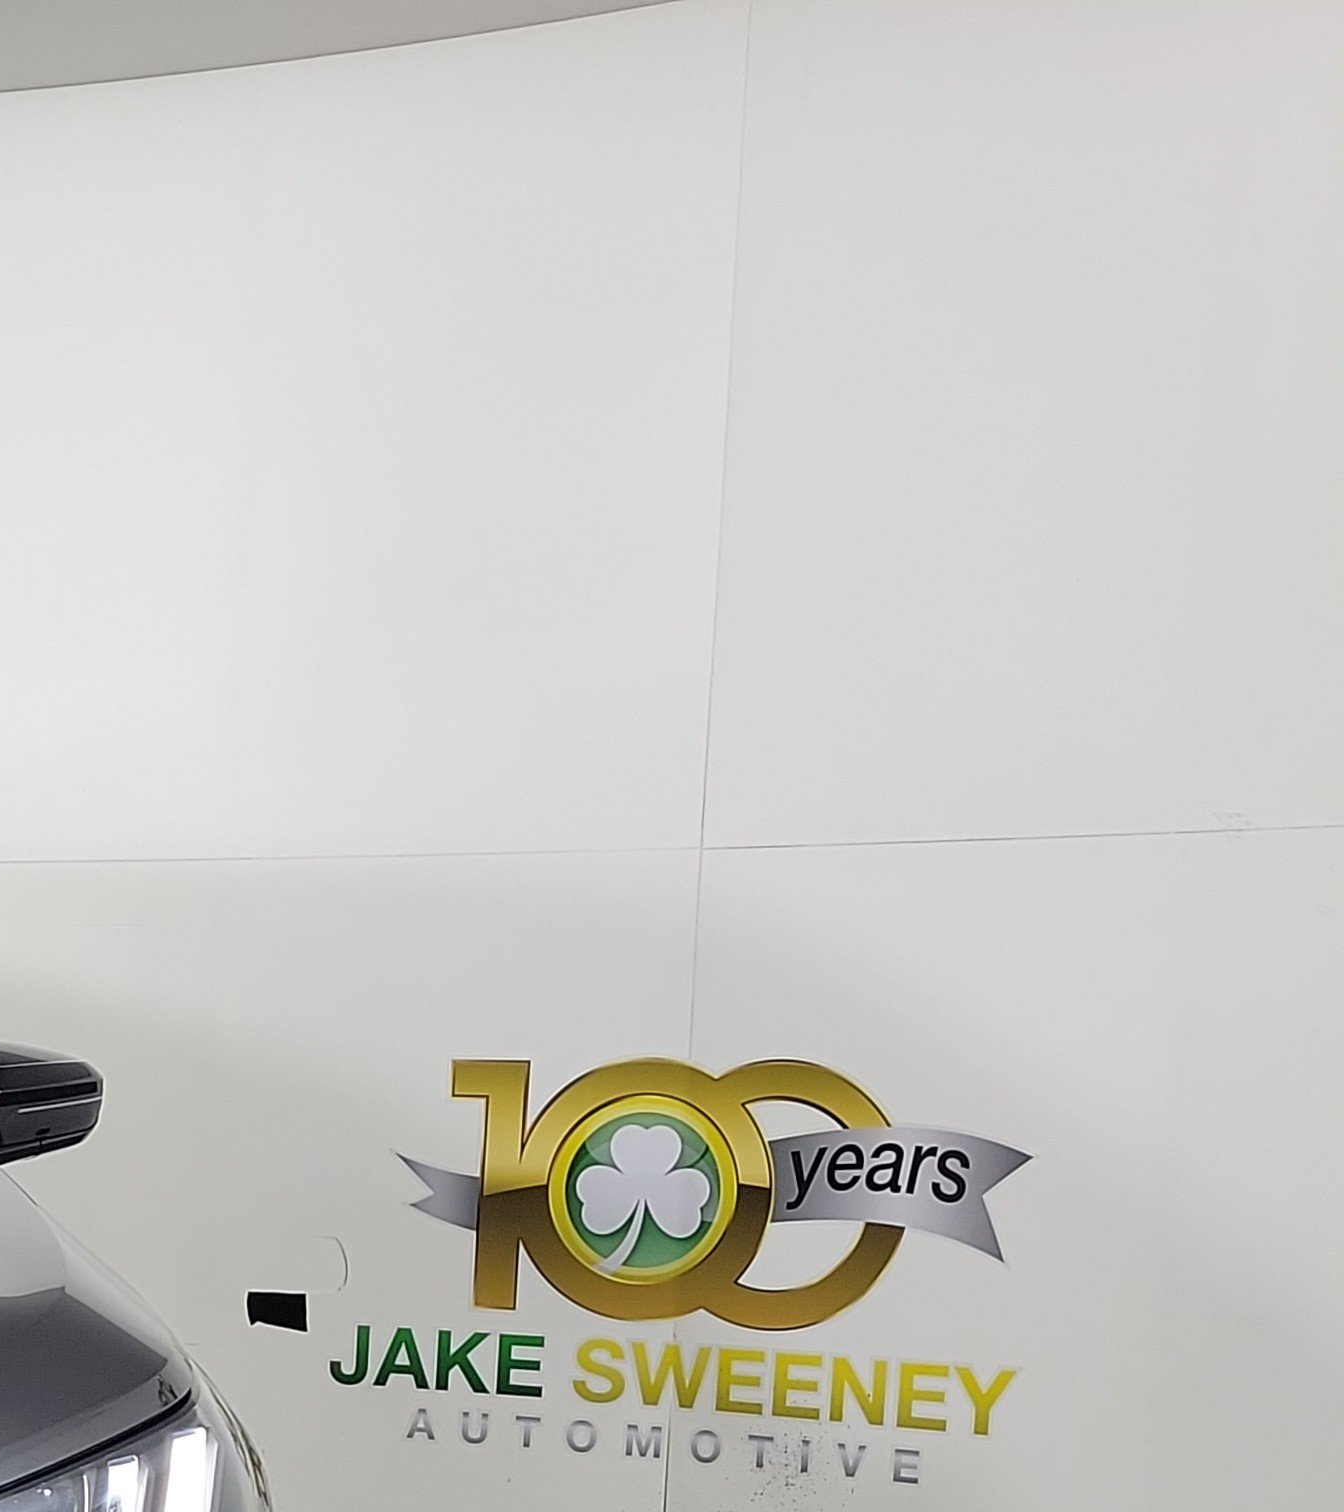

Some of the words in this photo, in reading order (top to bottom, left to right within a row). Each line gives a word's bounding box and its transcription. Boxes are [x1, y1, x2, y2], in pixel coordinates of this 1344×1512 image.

[451, 1057, 907, 1331] 100
[785, 1143, 970, 1210] years
[329, 1325, 545, 1398] JAKE
[572, 1338, 1018, 1436] SWEENEY
[407, 1408, 920, 1486] AUTOMOTIVE
